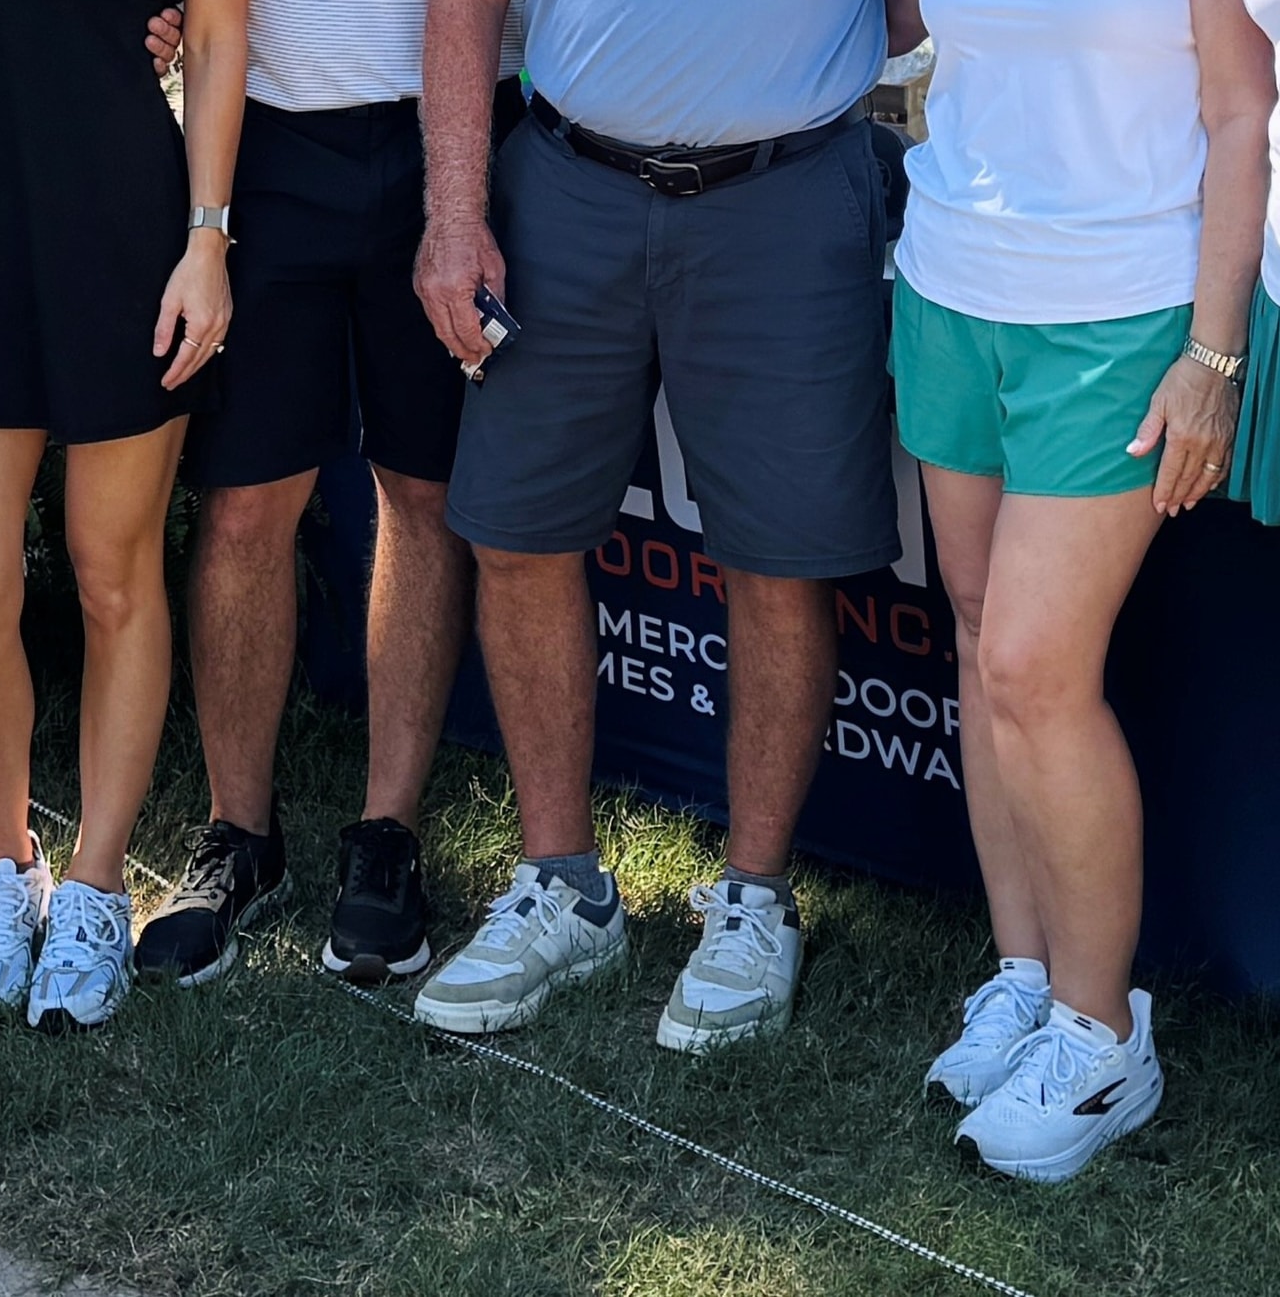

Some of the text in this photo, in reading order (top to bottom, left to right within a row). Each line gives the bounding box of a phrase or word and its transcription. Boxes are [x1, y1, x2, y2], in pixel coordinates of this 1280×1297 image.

[595, 530, 953, 662] OOR NC.
[598, 601, 728, 671] MERC
[690, 683, 715, 716] &
